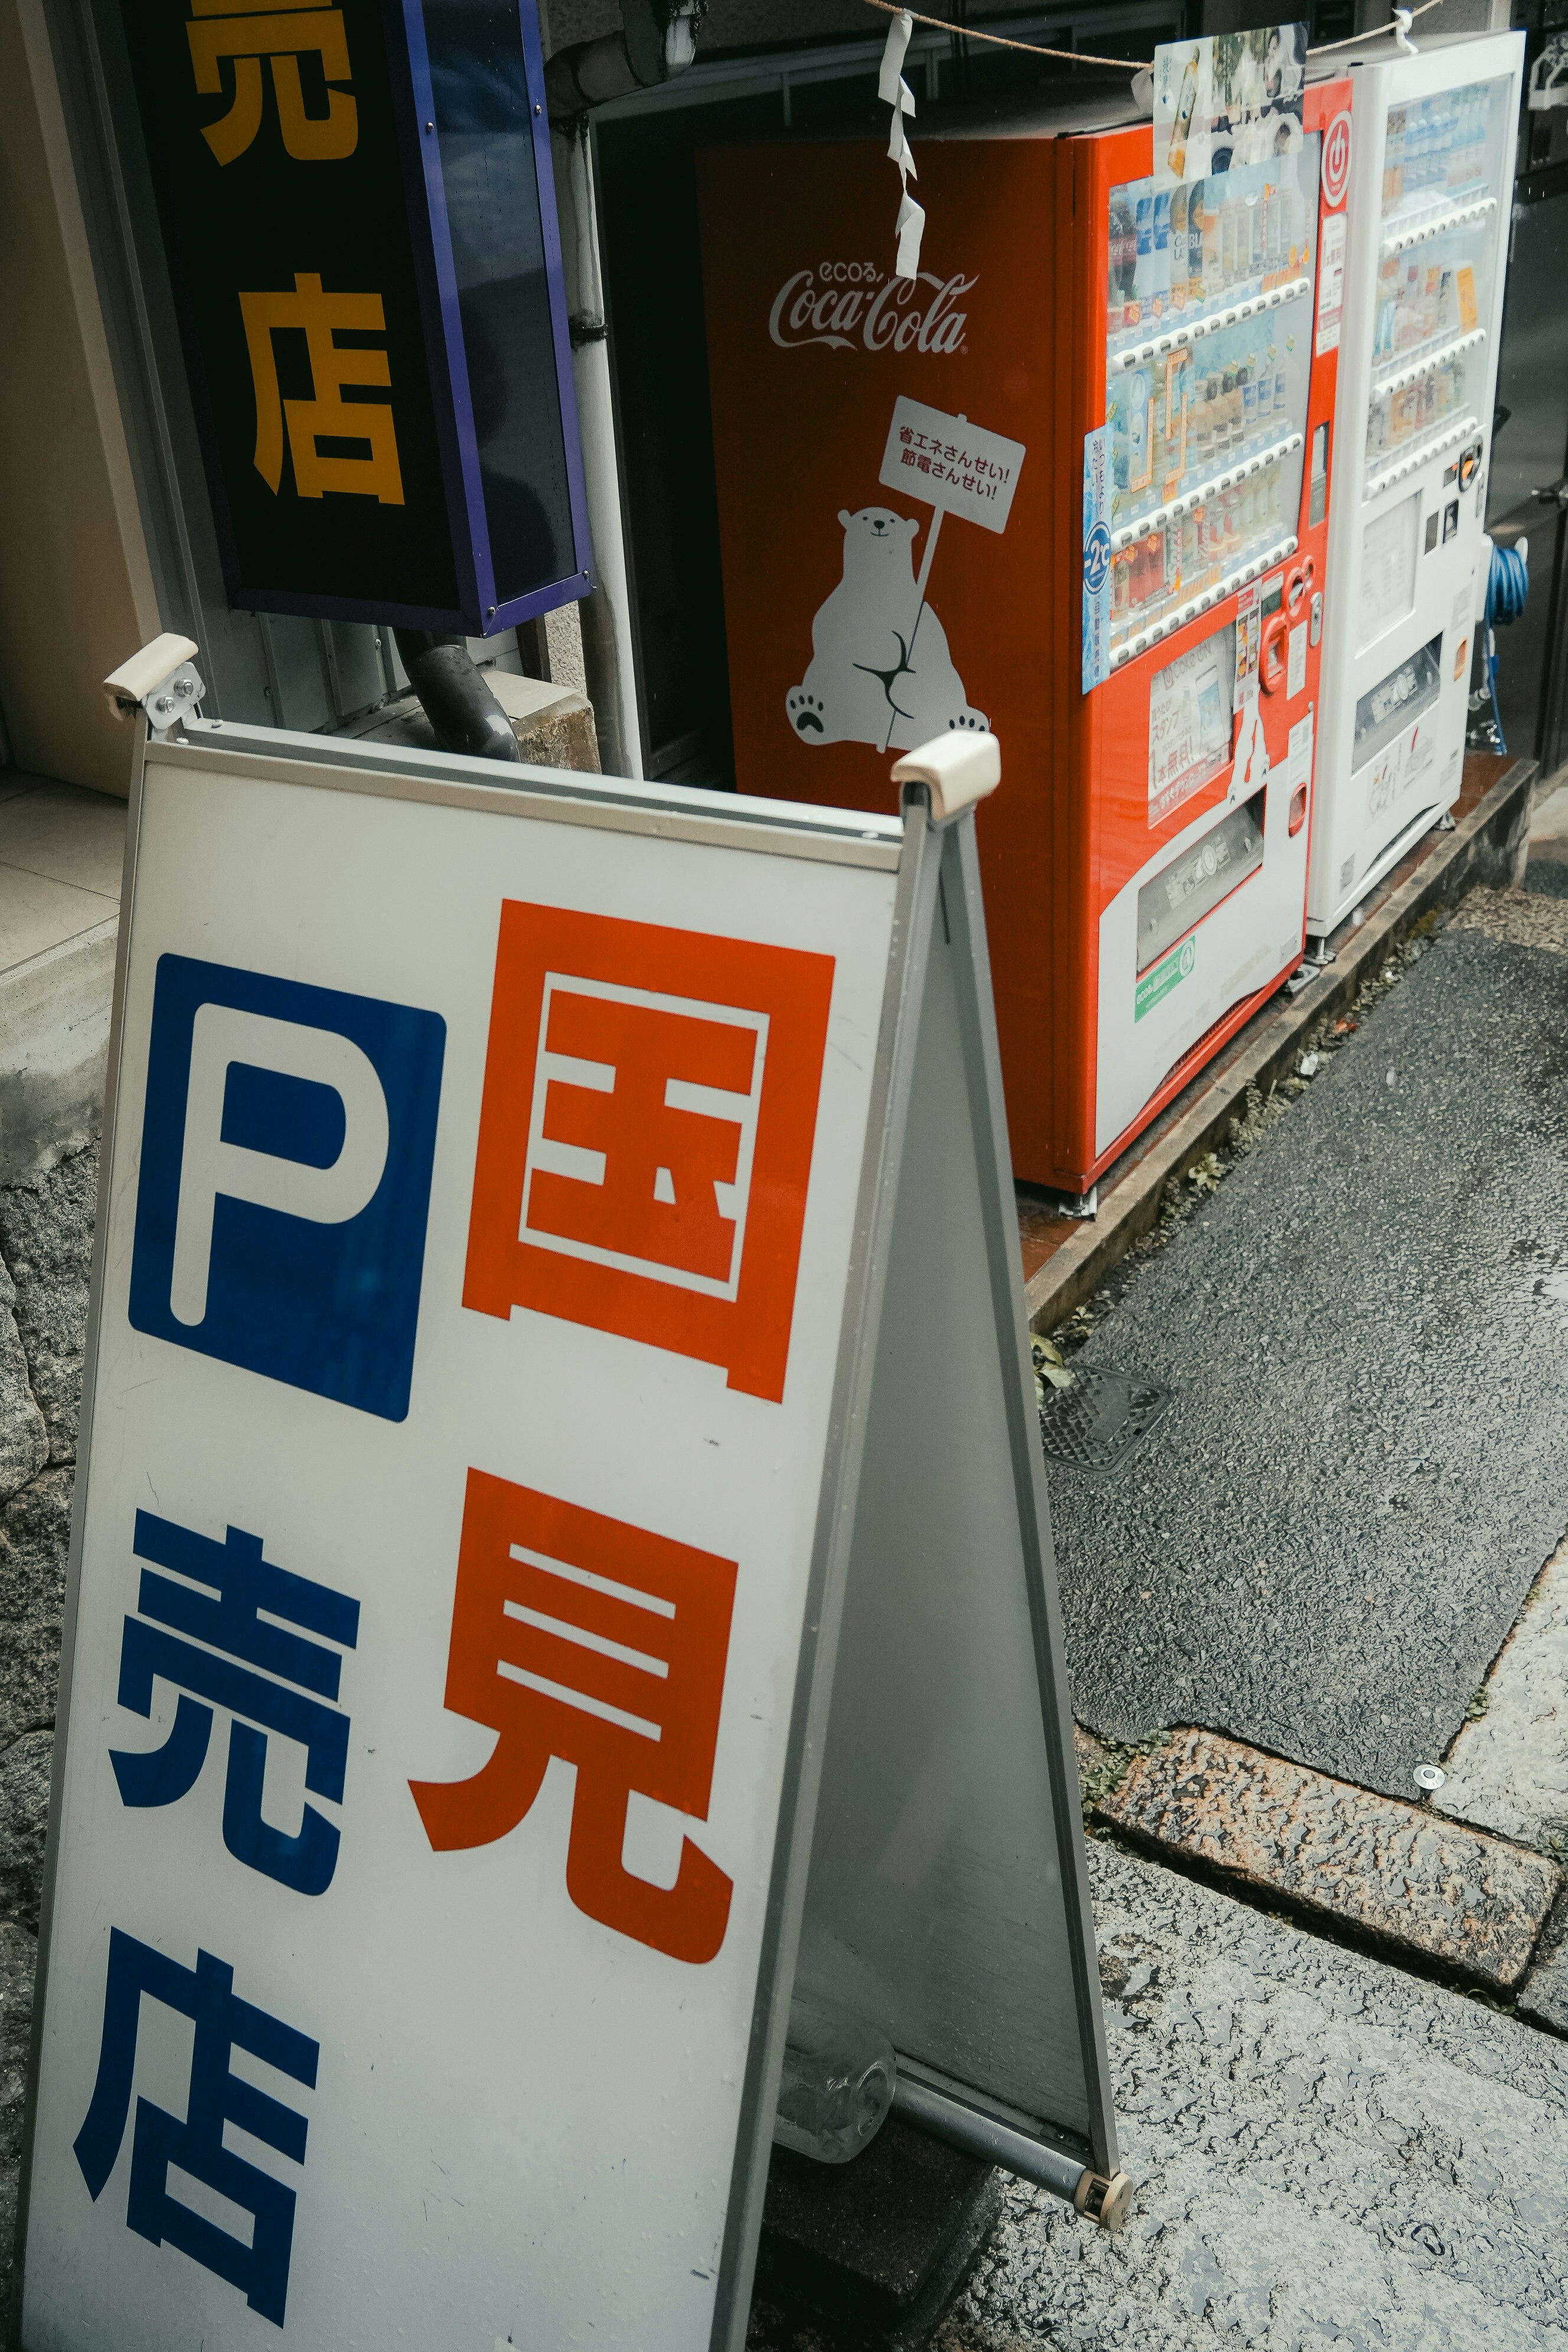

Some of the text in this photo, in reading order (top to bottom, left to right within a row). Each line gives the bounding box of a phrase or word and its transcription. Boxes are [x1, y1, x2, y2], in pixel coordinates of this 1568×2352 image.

[769, 269, 980, 354] Coca-Cola
[899, 426, 1010, 484] 省エネさんせい!
[900, 447, 997, 500] 節電さんせい!
[169, 1002, 390, 1327] P
[407, 899, 837, 1965] 国見
[72, 1507, 361, 2330] 売店
